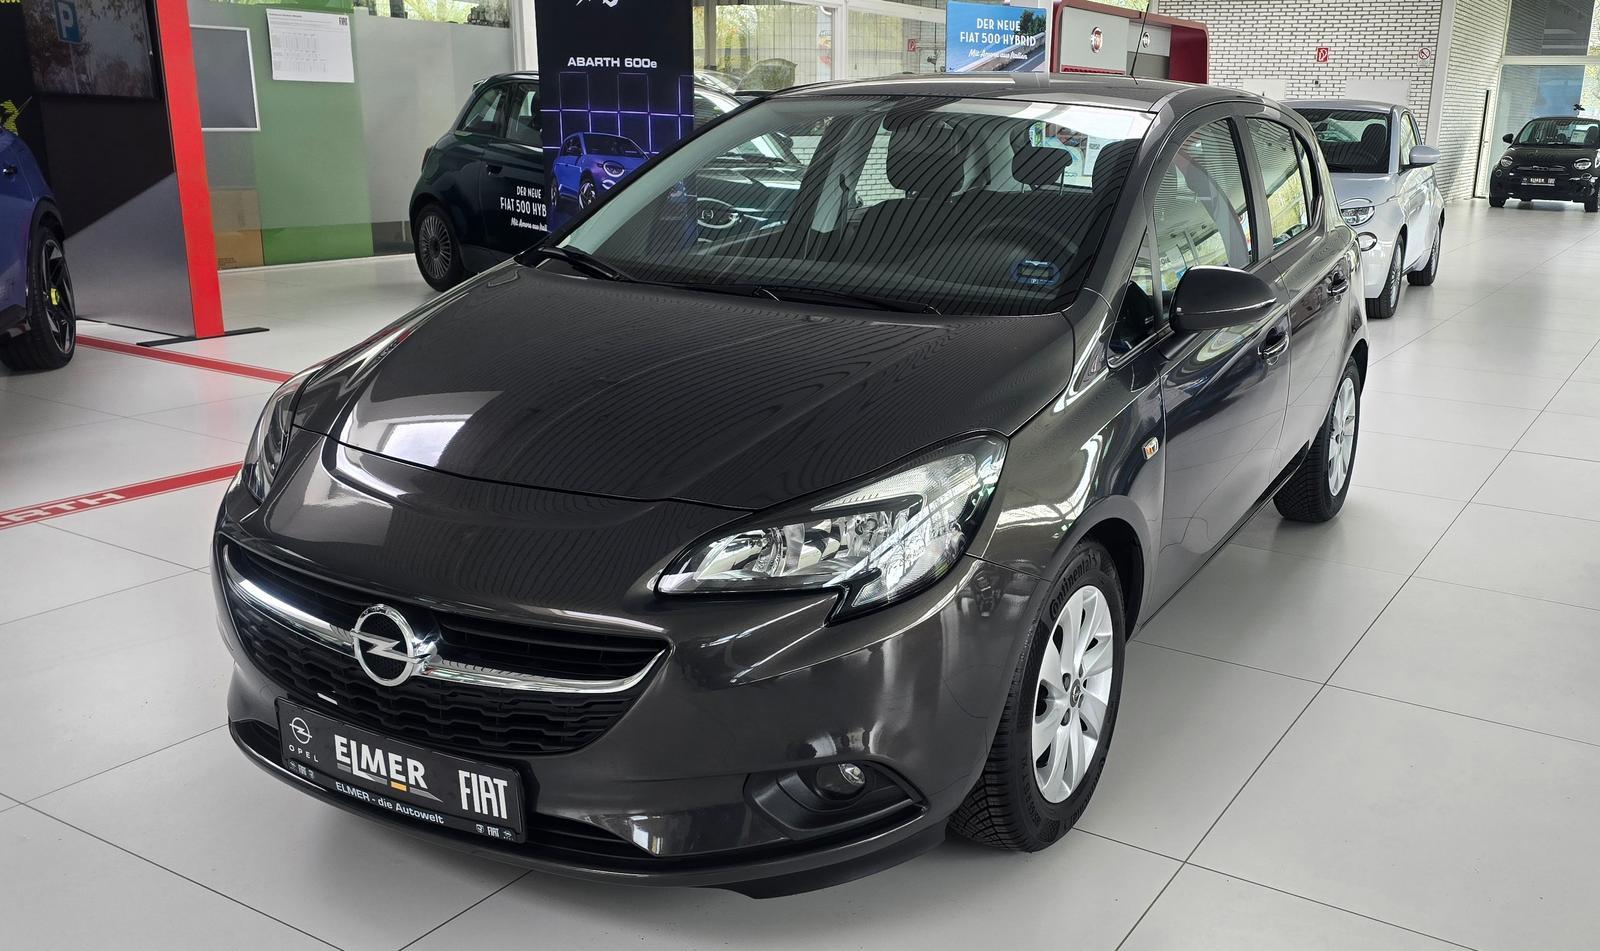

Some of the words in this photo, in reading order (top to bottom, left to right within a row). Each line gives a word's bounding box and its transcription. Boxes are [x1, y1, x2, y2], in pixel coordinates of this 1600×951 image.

[58, 1, 73, 38] P
[977, 18, 995, 29] DER
[997, 19, 1021, 31] NEUE
[960, 31, 980, 43] FIAT
[981, 32, 1001, 44] 500
[1003, 33, 1037, 47] HYBRID
[567, 56, 620, 67] ABARTH
[624, 58, 657, 68] 600e
[517, 186, 527, 196] DER
[528, 188, 541, 199] NEUE
[501, 197, 515, 211] FIAT
[516, 200, 531, 214] 500
[288, 744, 319, 763] OPEL
[334, 734, 428, 789] ELMER
[335, 781, 371, 802] ELMER
[377, 797, 393, 810] die
[395, 802, 445, 825] Autowelt
[458, 769, 508, 820] FIAT
[486, 826, 500, 838] FIAT
